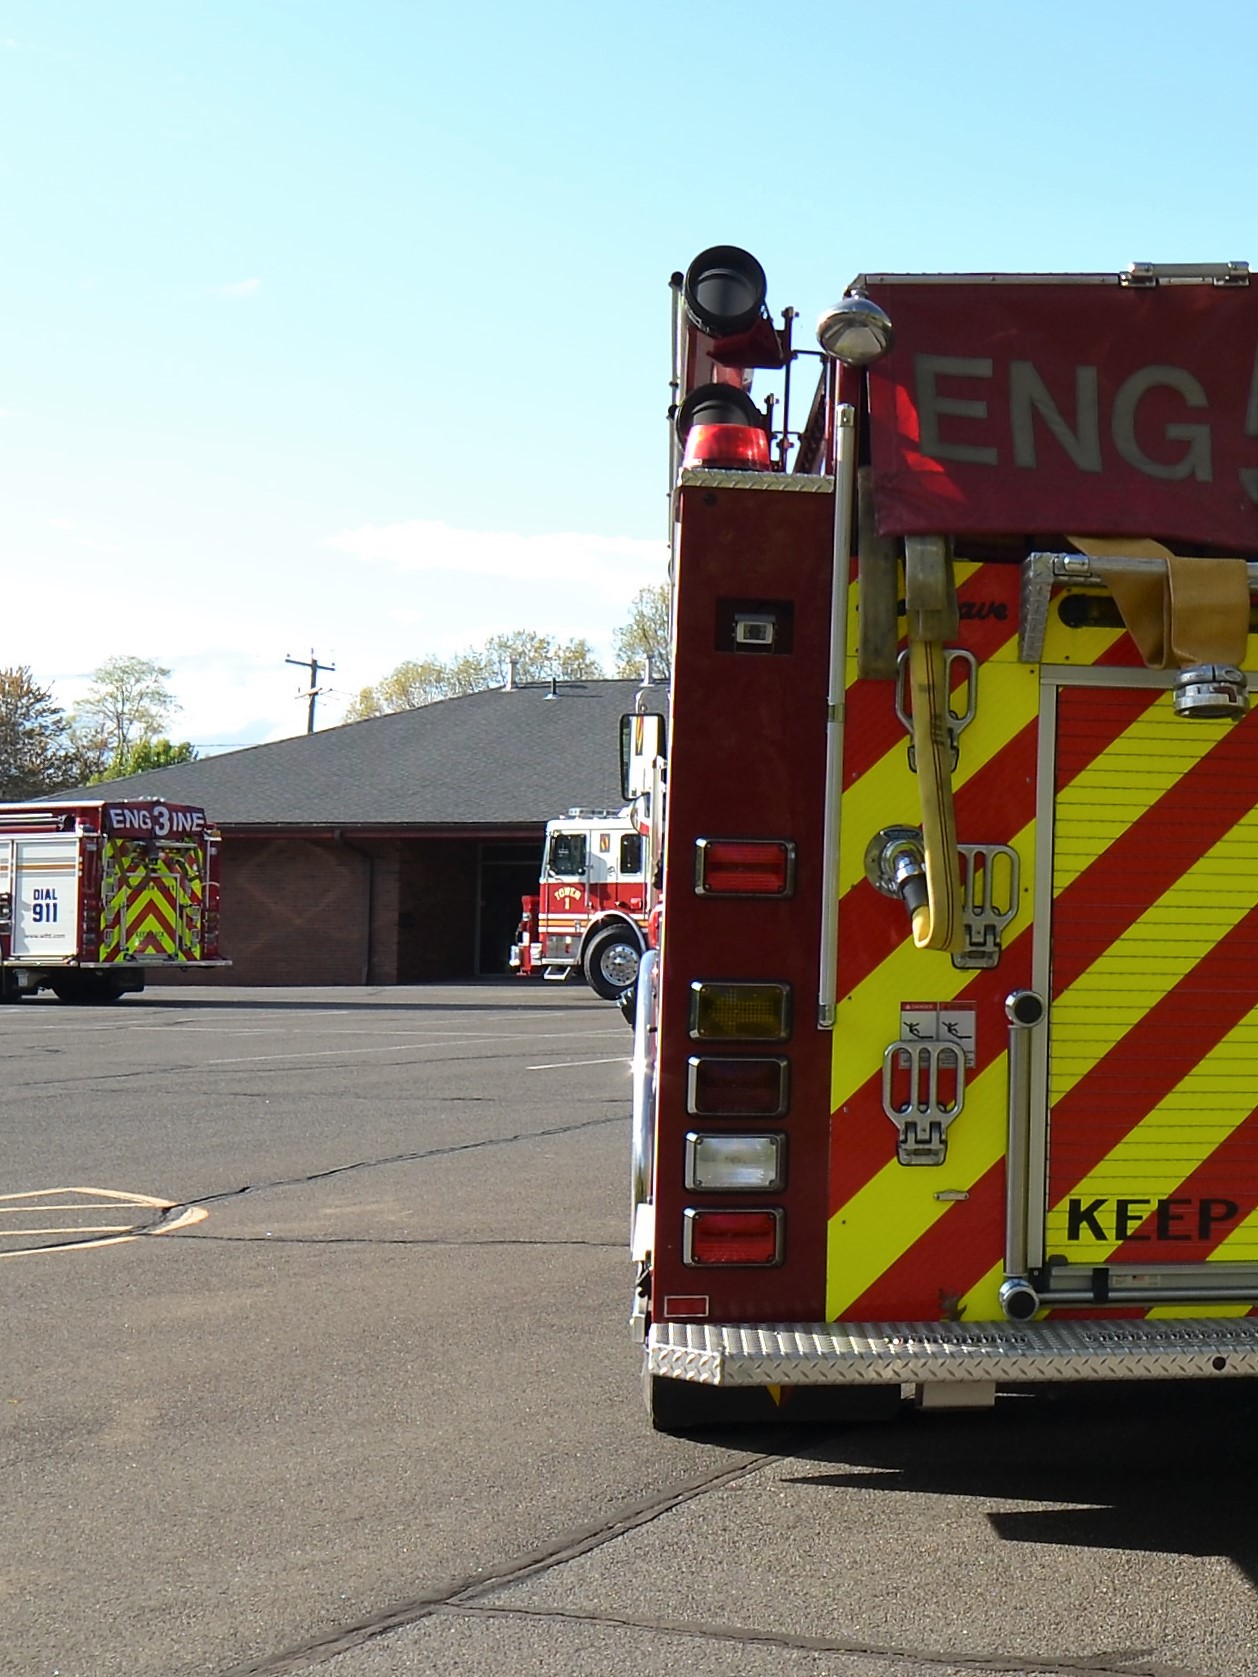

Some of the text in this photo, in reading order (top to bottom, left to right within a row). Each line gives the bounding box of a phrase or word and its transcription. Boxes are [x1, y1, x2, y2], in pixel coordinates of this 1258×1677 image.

[913, 353, 1213, 484] ENG
[110, 806, 204, 836] ENG 3 INE
[33, 888, 57, 900] DIAL
[564, 897, 570, 909] 1
[32, 903, 57, 922] 911
[1067, 1198, 1238, 1241] KEEP
